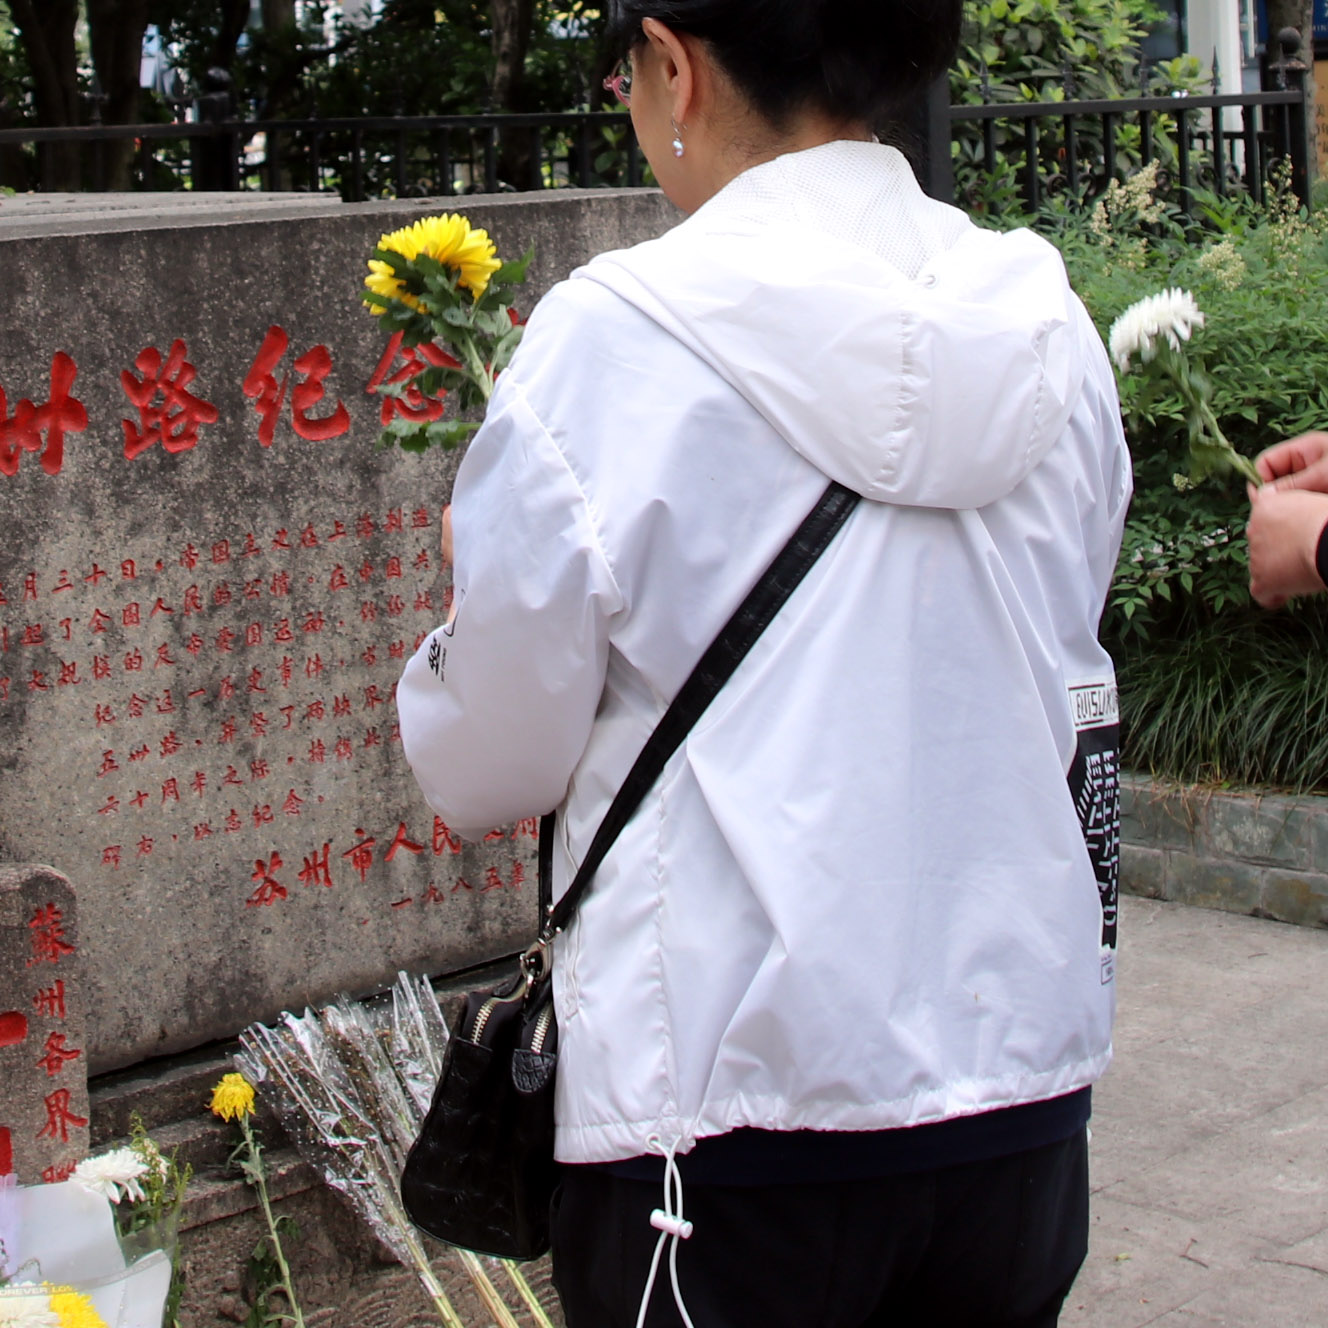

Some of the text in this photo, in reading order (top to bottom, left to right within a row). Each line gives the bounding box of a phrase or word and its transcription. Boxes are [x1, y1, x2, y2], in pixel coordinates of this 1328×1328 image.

[390, 859, 539, 910] 一九八五年
